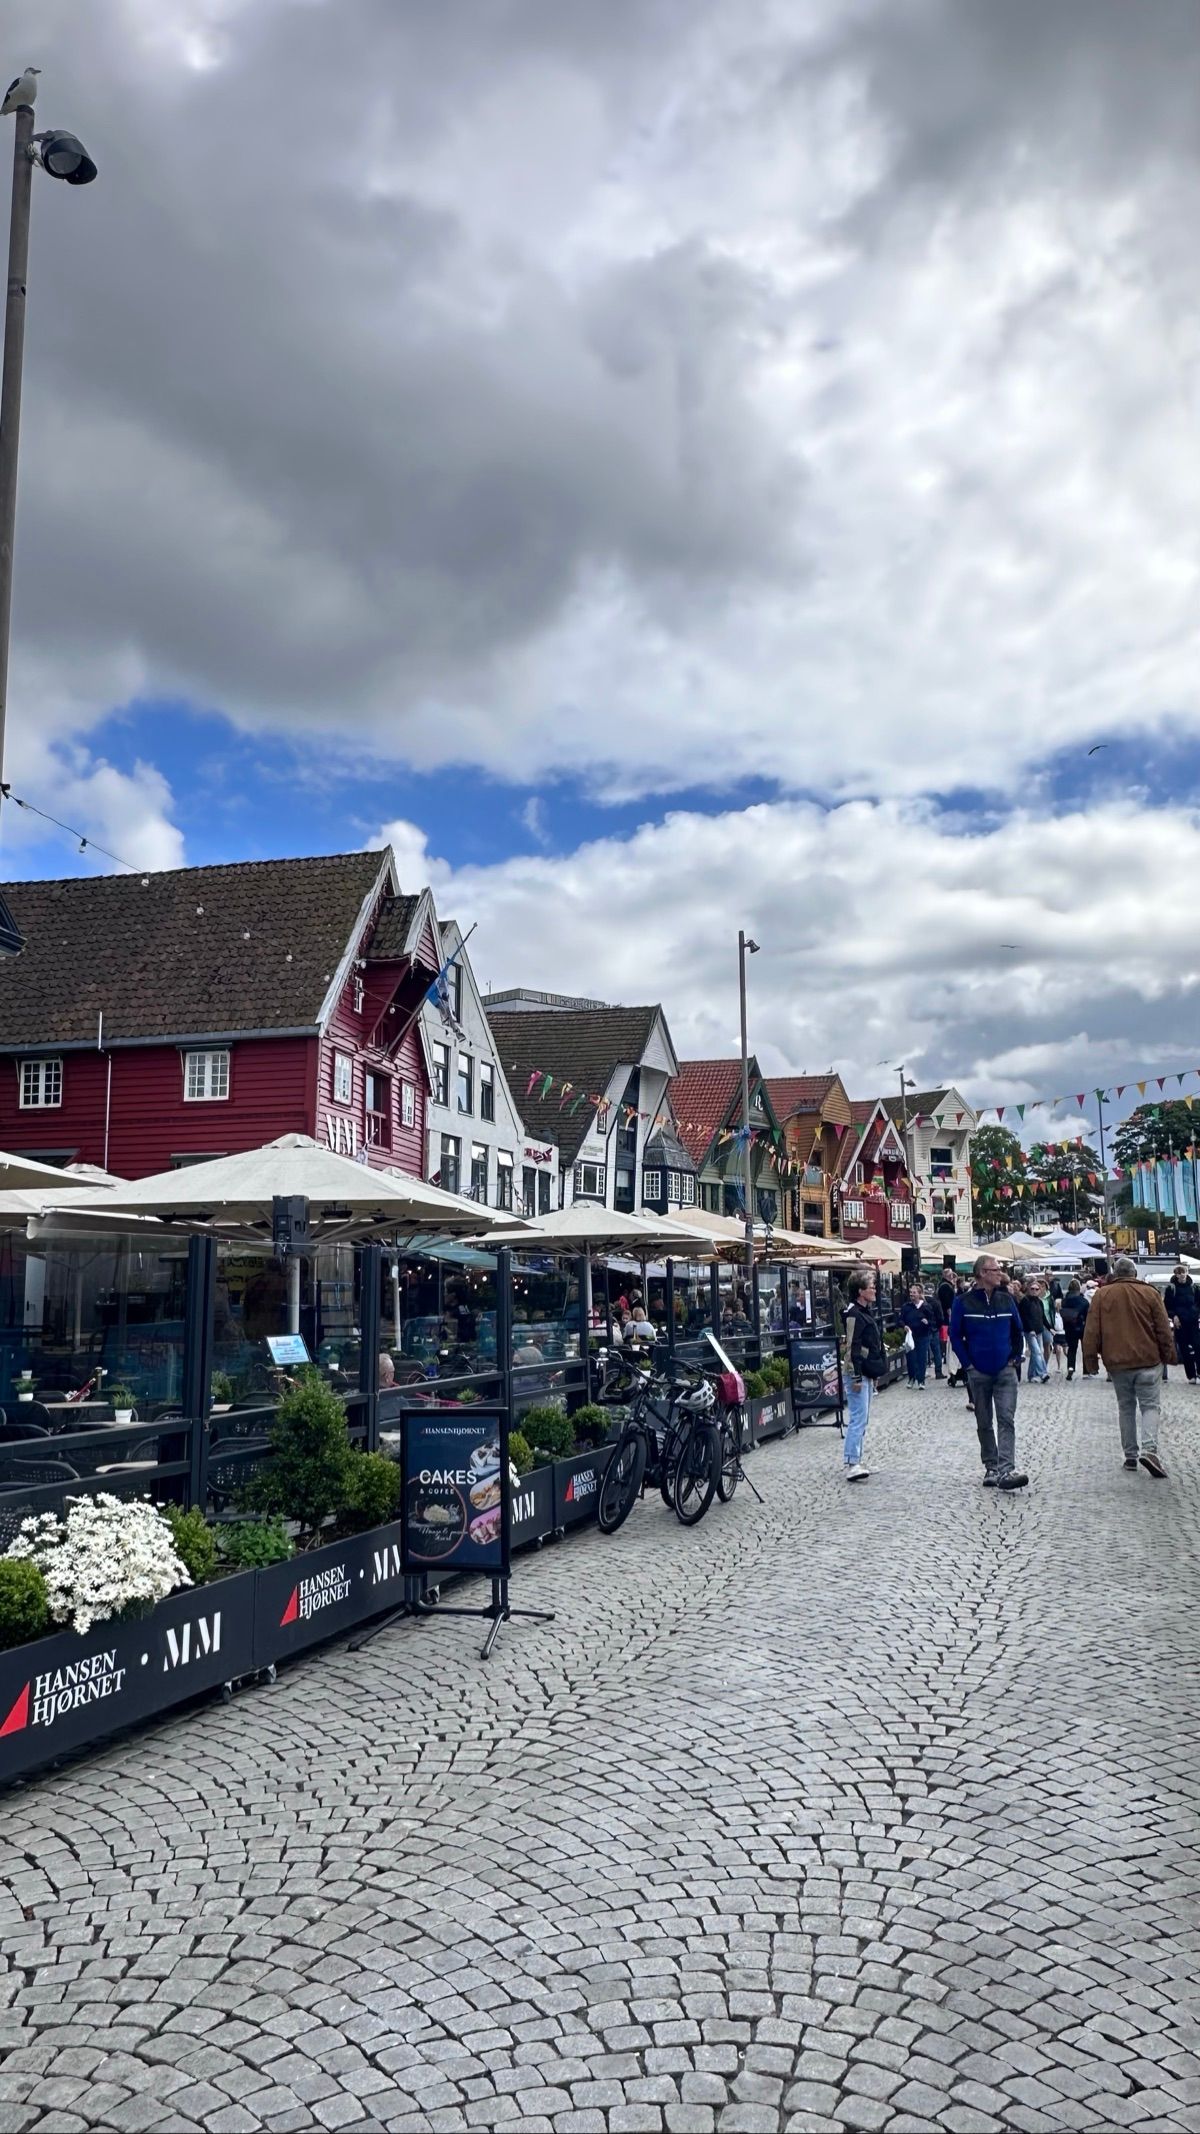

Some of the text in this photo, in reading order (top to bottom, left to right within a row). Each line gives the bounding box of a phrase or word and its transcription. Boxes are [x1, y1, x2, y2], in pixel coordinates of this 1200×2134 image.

[798, 1363, 826, 1371] CAKES
[419, 1469, 477, 1485] CAKES
[299, 1564, 346, 1599] HANSEN
[299, 1579, 352, 1620] HJØRNET
[34, 1611, 221, 1700] HANSEN MM
[31, 1668, 126, 1727] HJØRNET
